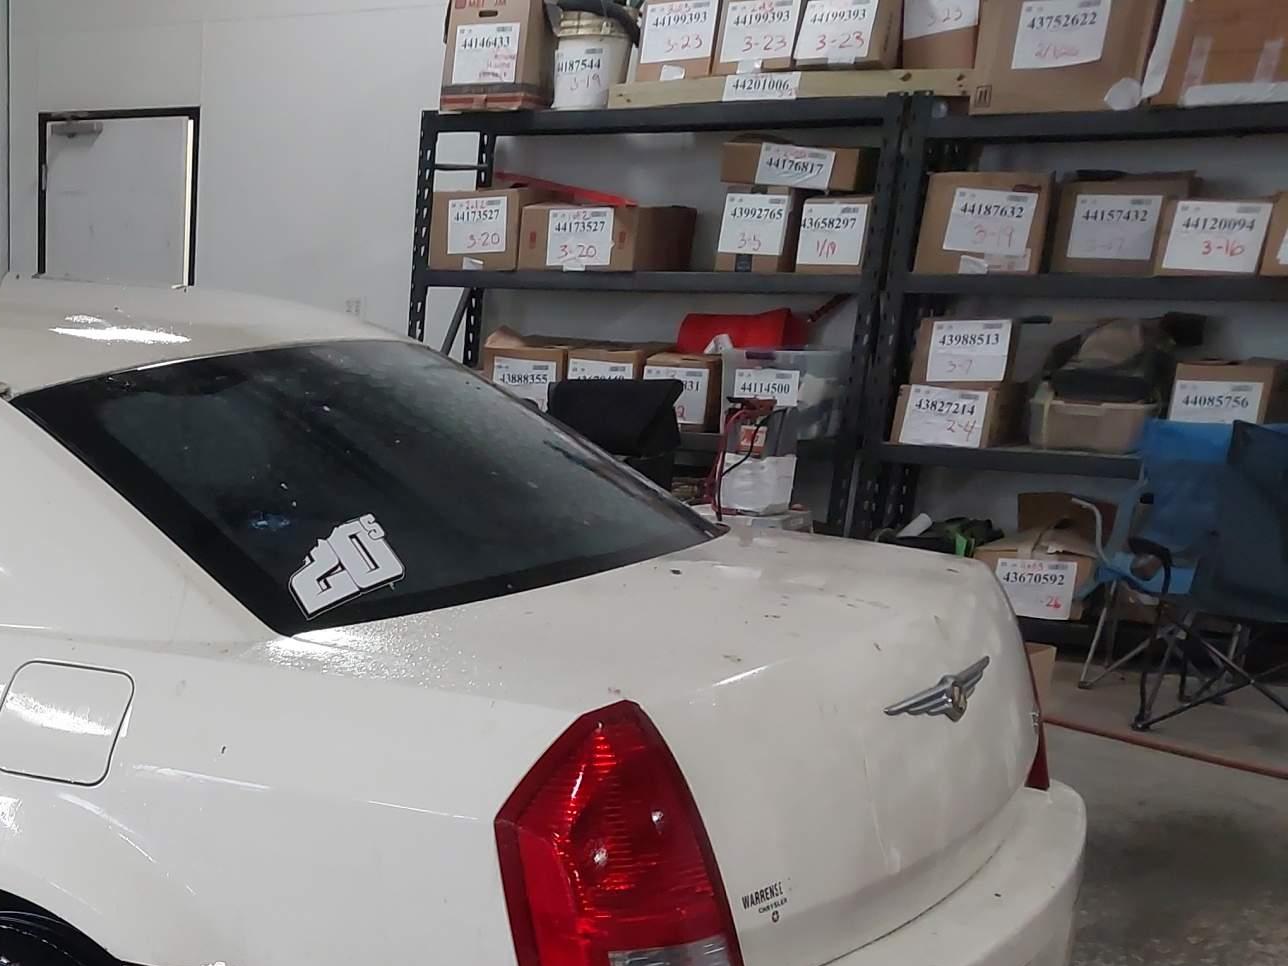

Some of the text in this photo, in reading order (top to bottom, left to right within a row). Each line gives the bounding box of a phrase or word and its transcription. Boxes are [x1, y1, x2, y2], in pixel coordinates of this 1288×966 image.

[652, 11, 707, 27] 44199393
[733, 10, 790, 26] 44199393
[811, 8, 866, 23] 44199393
[1027, 12, 1097, 29] 43752622
[462, 36, 510, 49] 44146433
[742, 34, 787, 52] 3-23
[816, 31, 865, 51] 3-23
[732, 79, 790, 90] 44201006
[766, 157, 824, 175] 44176817
[454, 209, 500, 223] 44173527
[731, 206, 783, 220] 43992765
[961, 202, 1024, 218] 44187632
[1082, 209, 1148, 222] 44157432
[555, 221, 605, 233] 44173527
[801, 217, 857, 230] 43658297
[1182, 217, 1256, 231] 44120094
[939, 333, 1000, 346] 43988513
[740, 382, 791, 394] 44114500
[915, 398, 976, 416] 43827214
[1182, 395, 1249, 408] 44085756
[1003, 572, 1065, 585] 43670592
